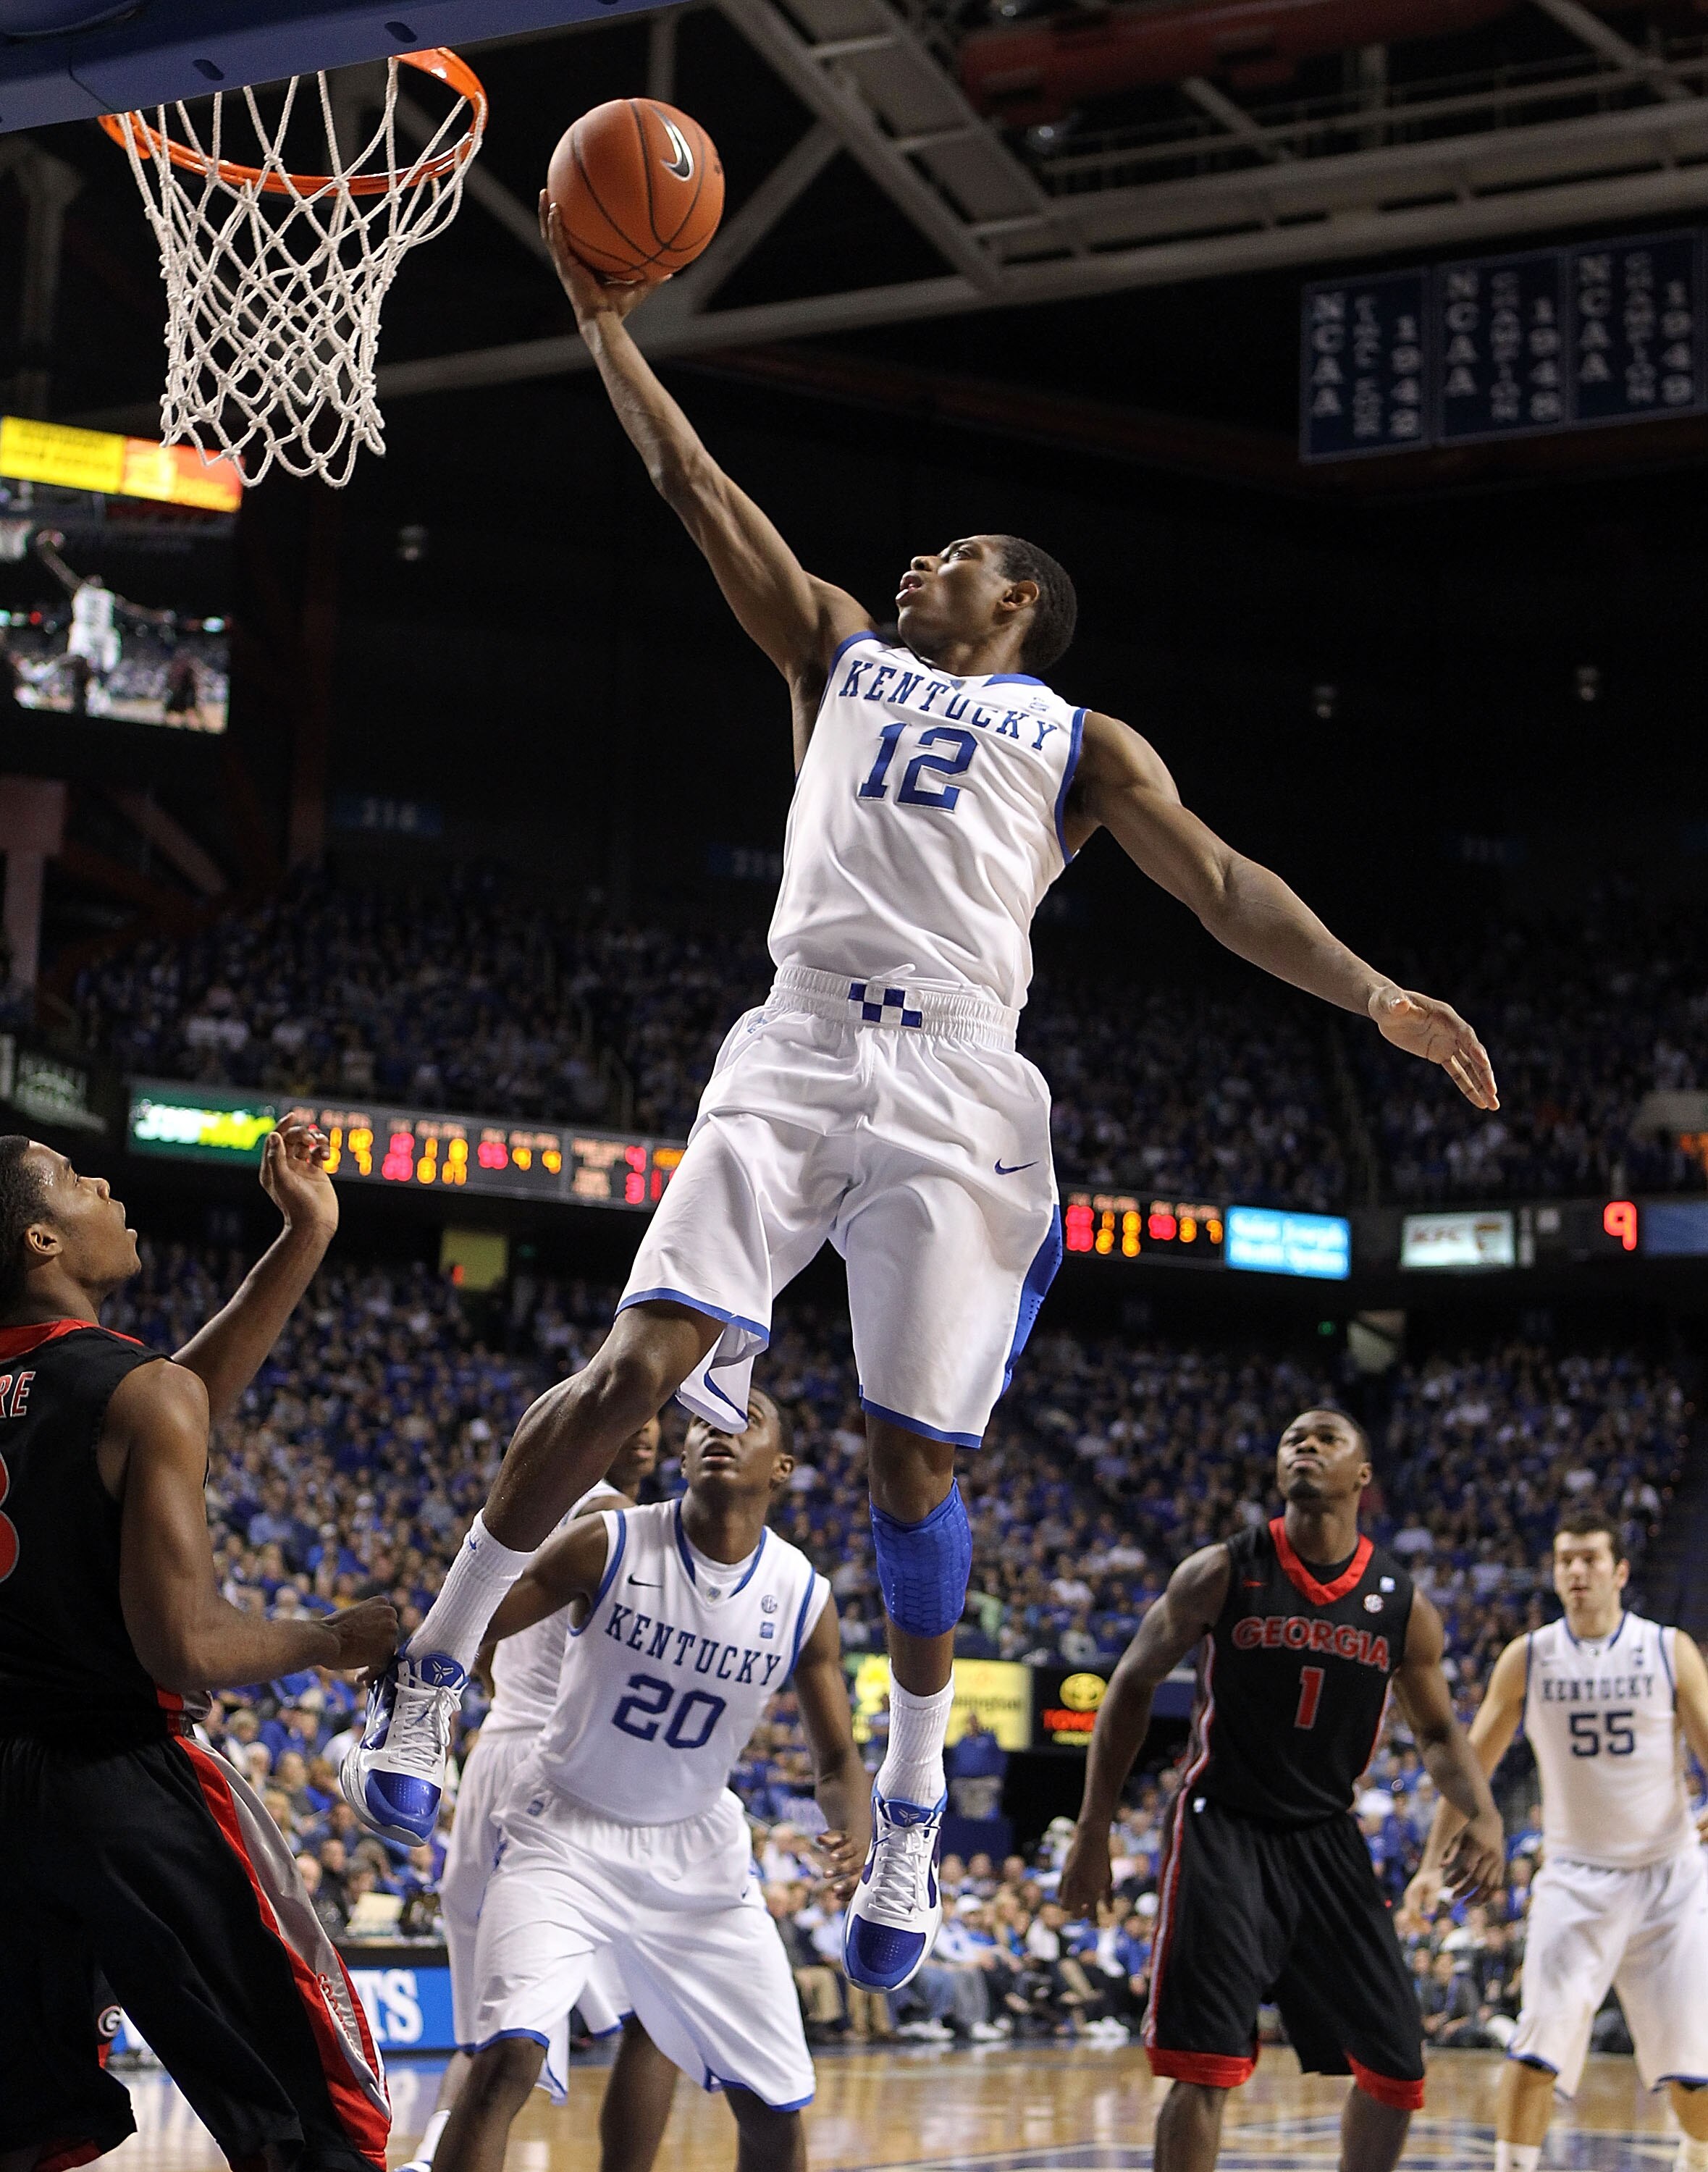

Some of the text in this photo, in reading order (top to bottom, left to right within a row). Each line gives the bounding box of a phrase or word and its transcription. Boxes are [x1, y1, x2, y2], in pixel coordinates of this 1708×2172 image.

[1311, 292, 1346, 418] NCAA
[1447, 270, 1481, 397] NCAA
[1578, 253, 1612, 383] NCAA
[838, 660, 1057, 751] KENTUCKY
[857, 722, 979, 814] 12
[1603, 1201, 1637, 1251] 9
[605, 1602, 781, 1686] KENTUCKY
[1232, 1615, 1389, 1673] GEORGIA
[612, 1672, 727, 1749] 20
[1294, 1665, 1326, 1730] 1
[1542, 1675, 1654, 1702] KENTUCKY
[1569, 1710, 1635, 1757] 55
